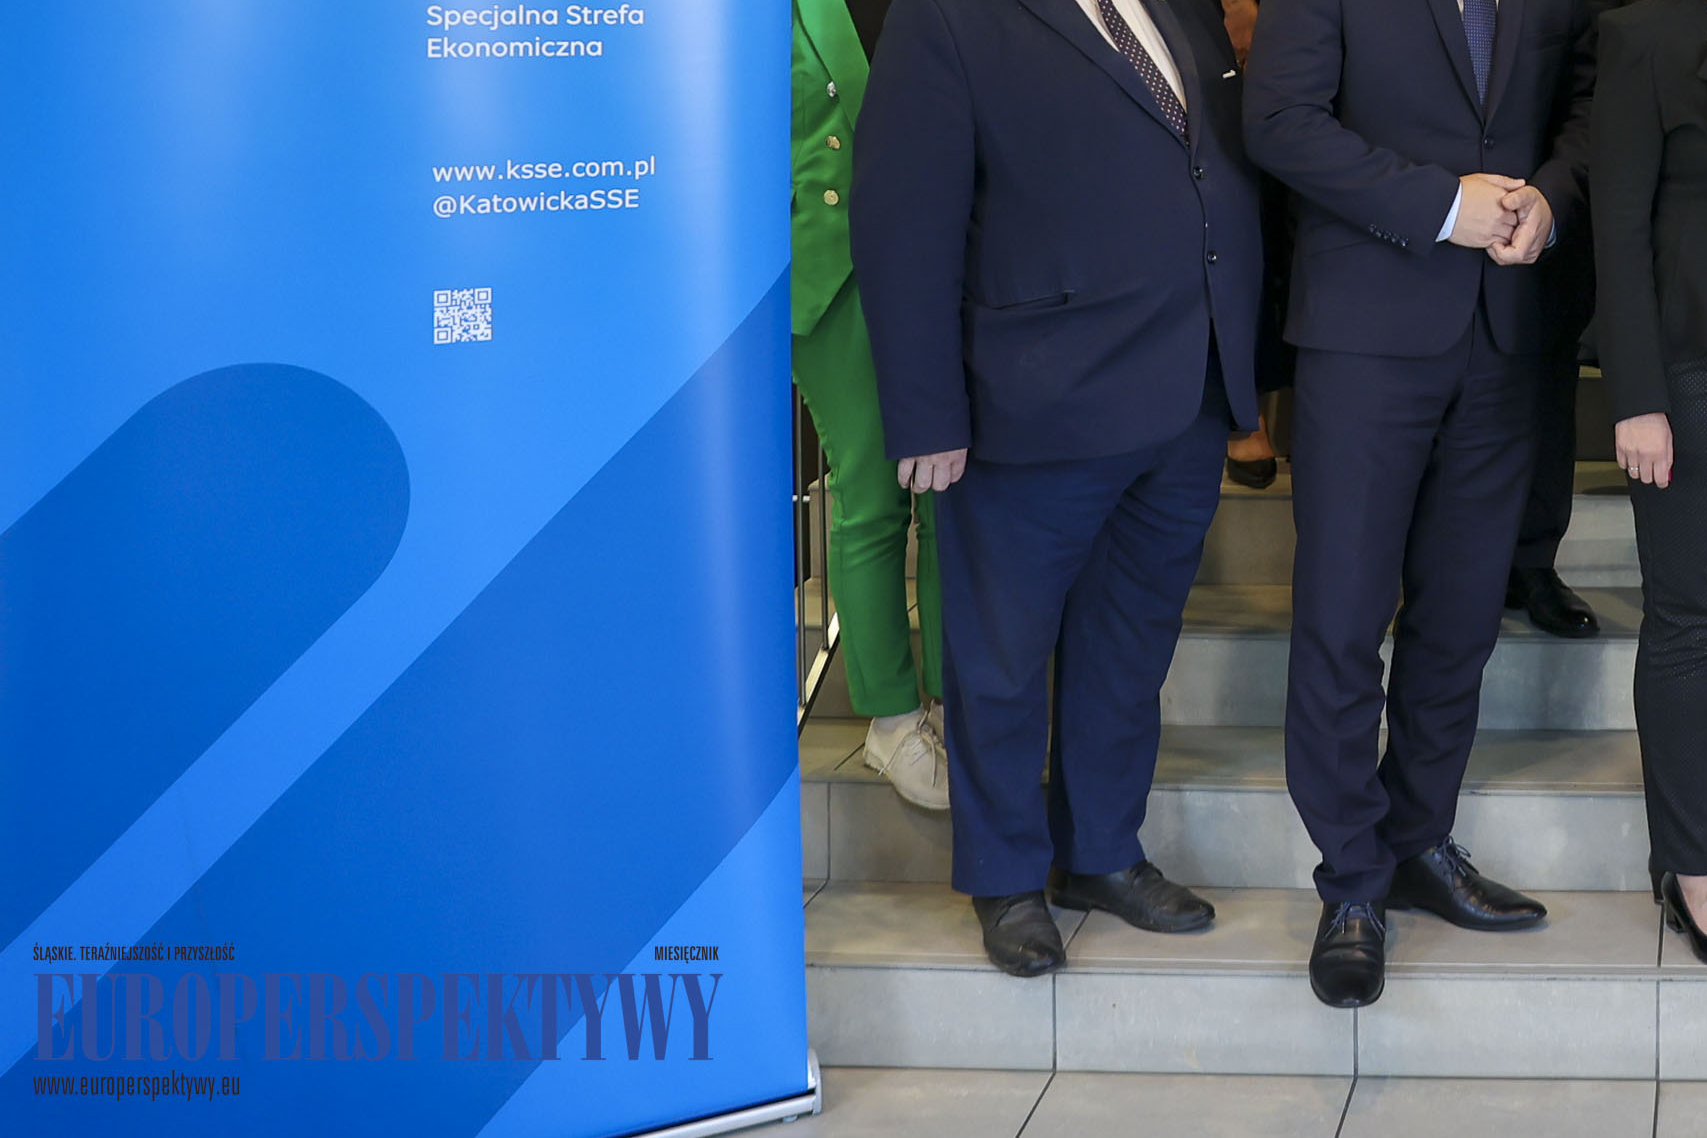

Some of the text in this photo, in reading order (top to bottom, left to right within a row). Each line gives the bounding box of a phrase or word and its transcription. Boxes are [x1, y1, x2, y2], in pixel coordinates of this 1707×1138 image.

[426, 3, 645, 31] Specjalna Strefa
[426, 36, 603, 58] Ekonomiczna
[432, 155, 656, 183] www.ksse.com.pl
[432, 188, 640, 219] @KatowickaSSE
